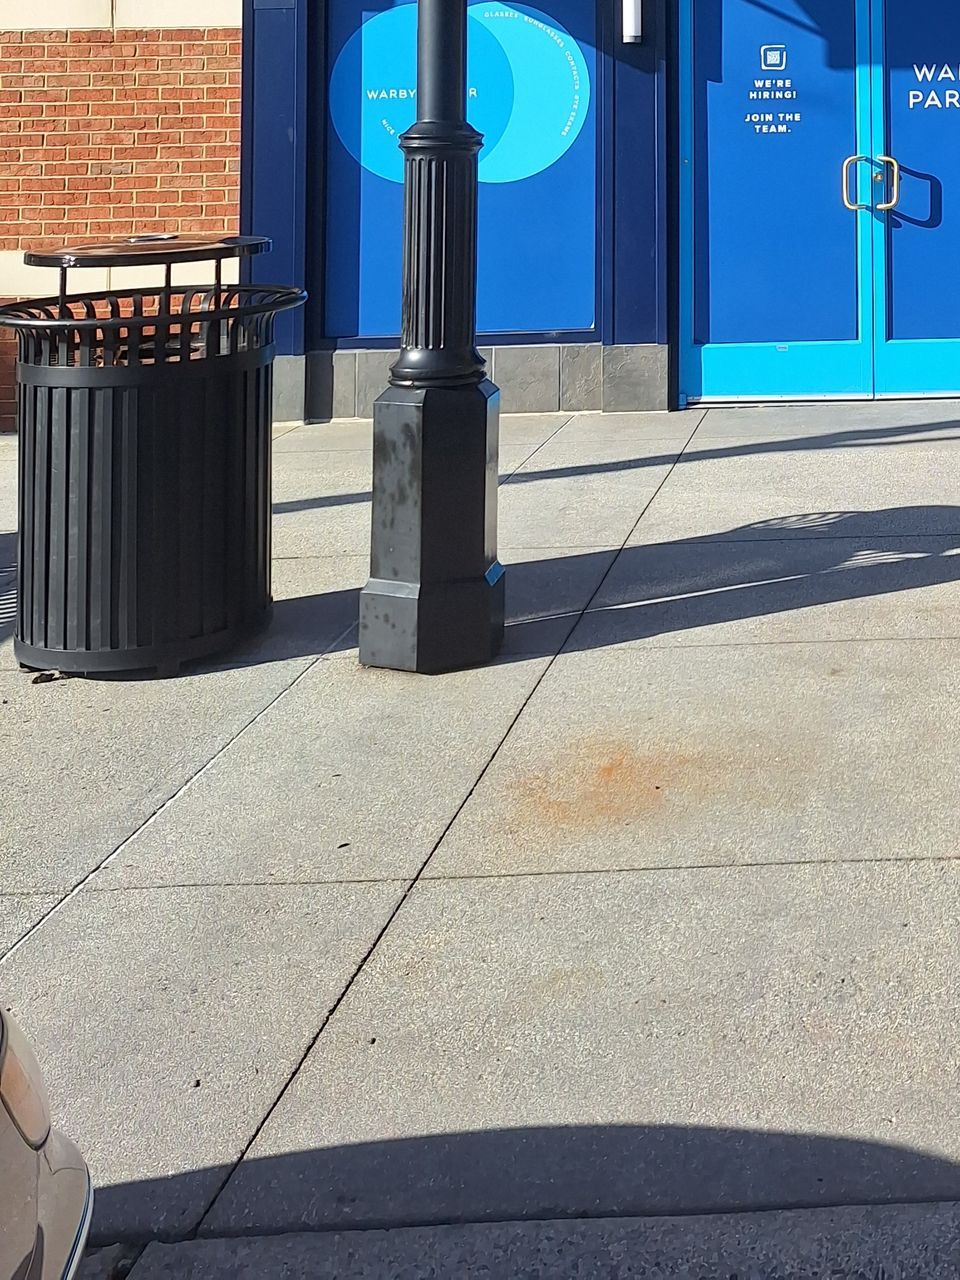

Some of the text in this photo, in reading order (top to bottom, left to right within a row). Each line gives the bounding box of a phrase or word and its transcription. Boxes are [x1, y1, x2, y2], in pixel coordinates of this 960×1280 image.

[565, 50, 580, 90] CONTACTS
[754, 79, 792, 88] WE'RE
[366, 88, 417, 100] WARBY
[749, 91, 797, 100] HIRING!
[744, 113, 801, 122] JOIN THE
[381, 119, 396, 136] NICE
[754, 124, 792, 133] TEAM.
